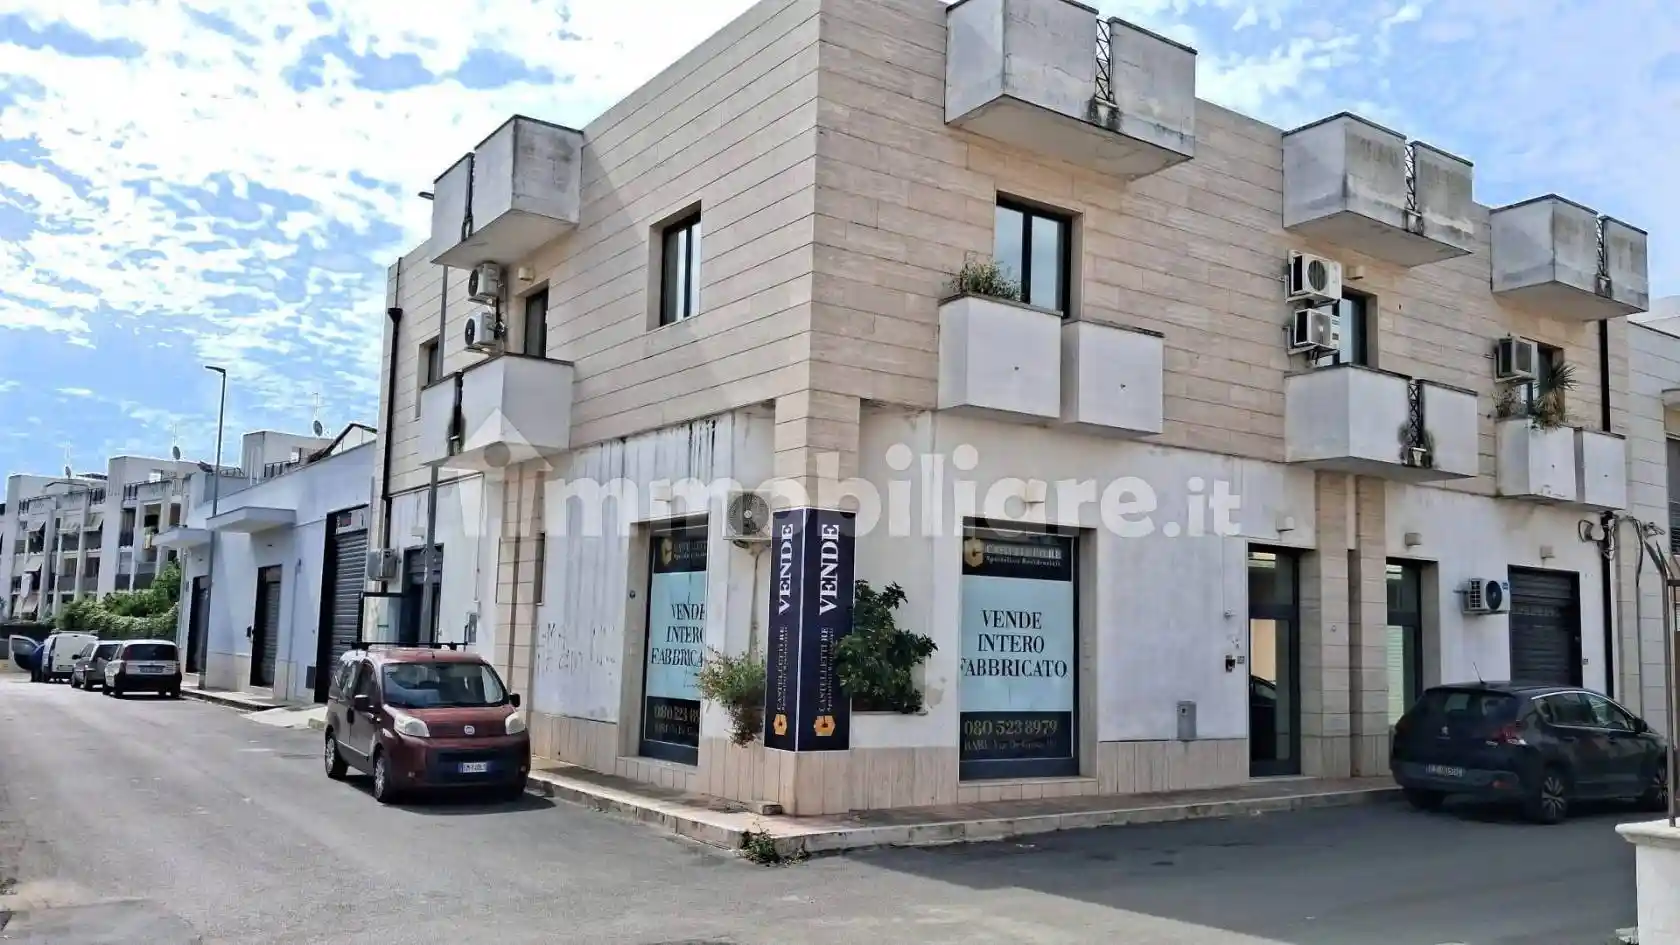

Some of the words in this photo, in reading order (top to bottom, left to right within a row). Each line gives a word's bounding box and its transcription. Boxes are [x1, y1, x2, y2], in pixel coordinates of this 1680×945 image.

[778, 523, 794, 616] VENDE
[819, 523, 840, 616] VENDE
[981, 609, 1042, 630] VENDE
[977, 633, 1045, 654] INTERO
[964, 719, 993, 736] 080
[995, 720, 1022, 736] 523
[1024, 720, 1058, 736] 8979
